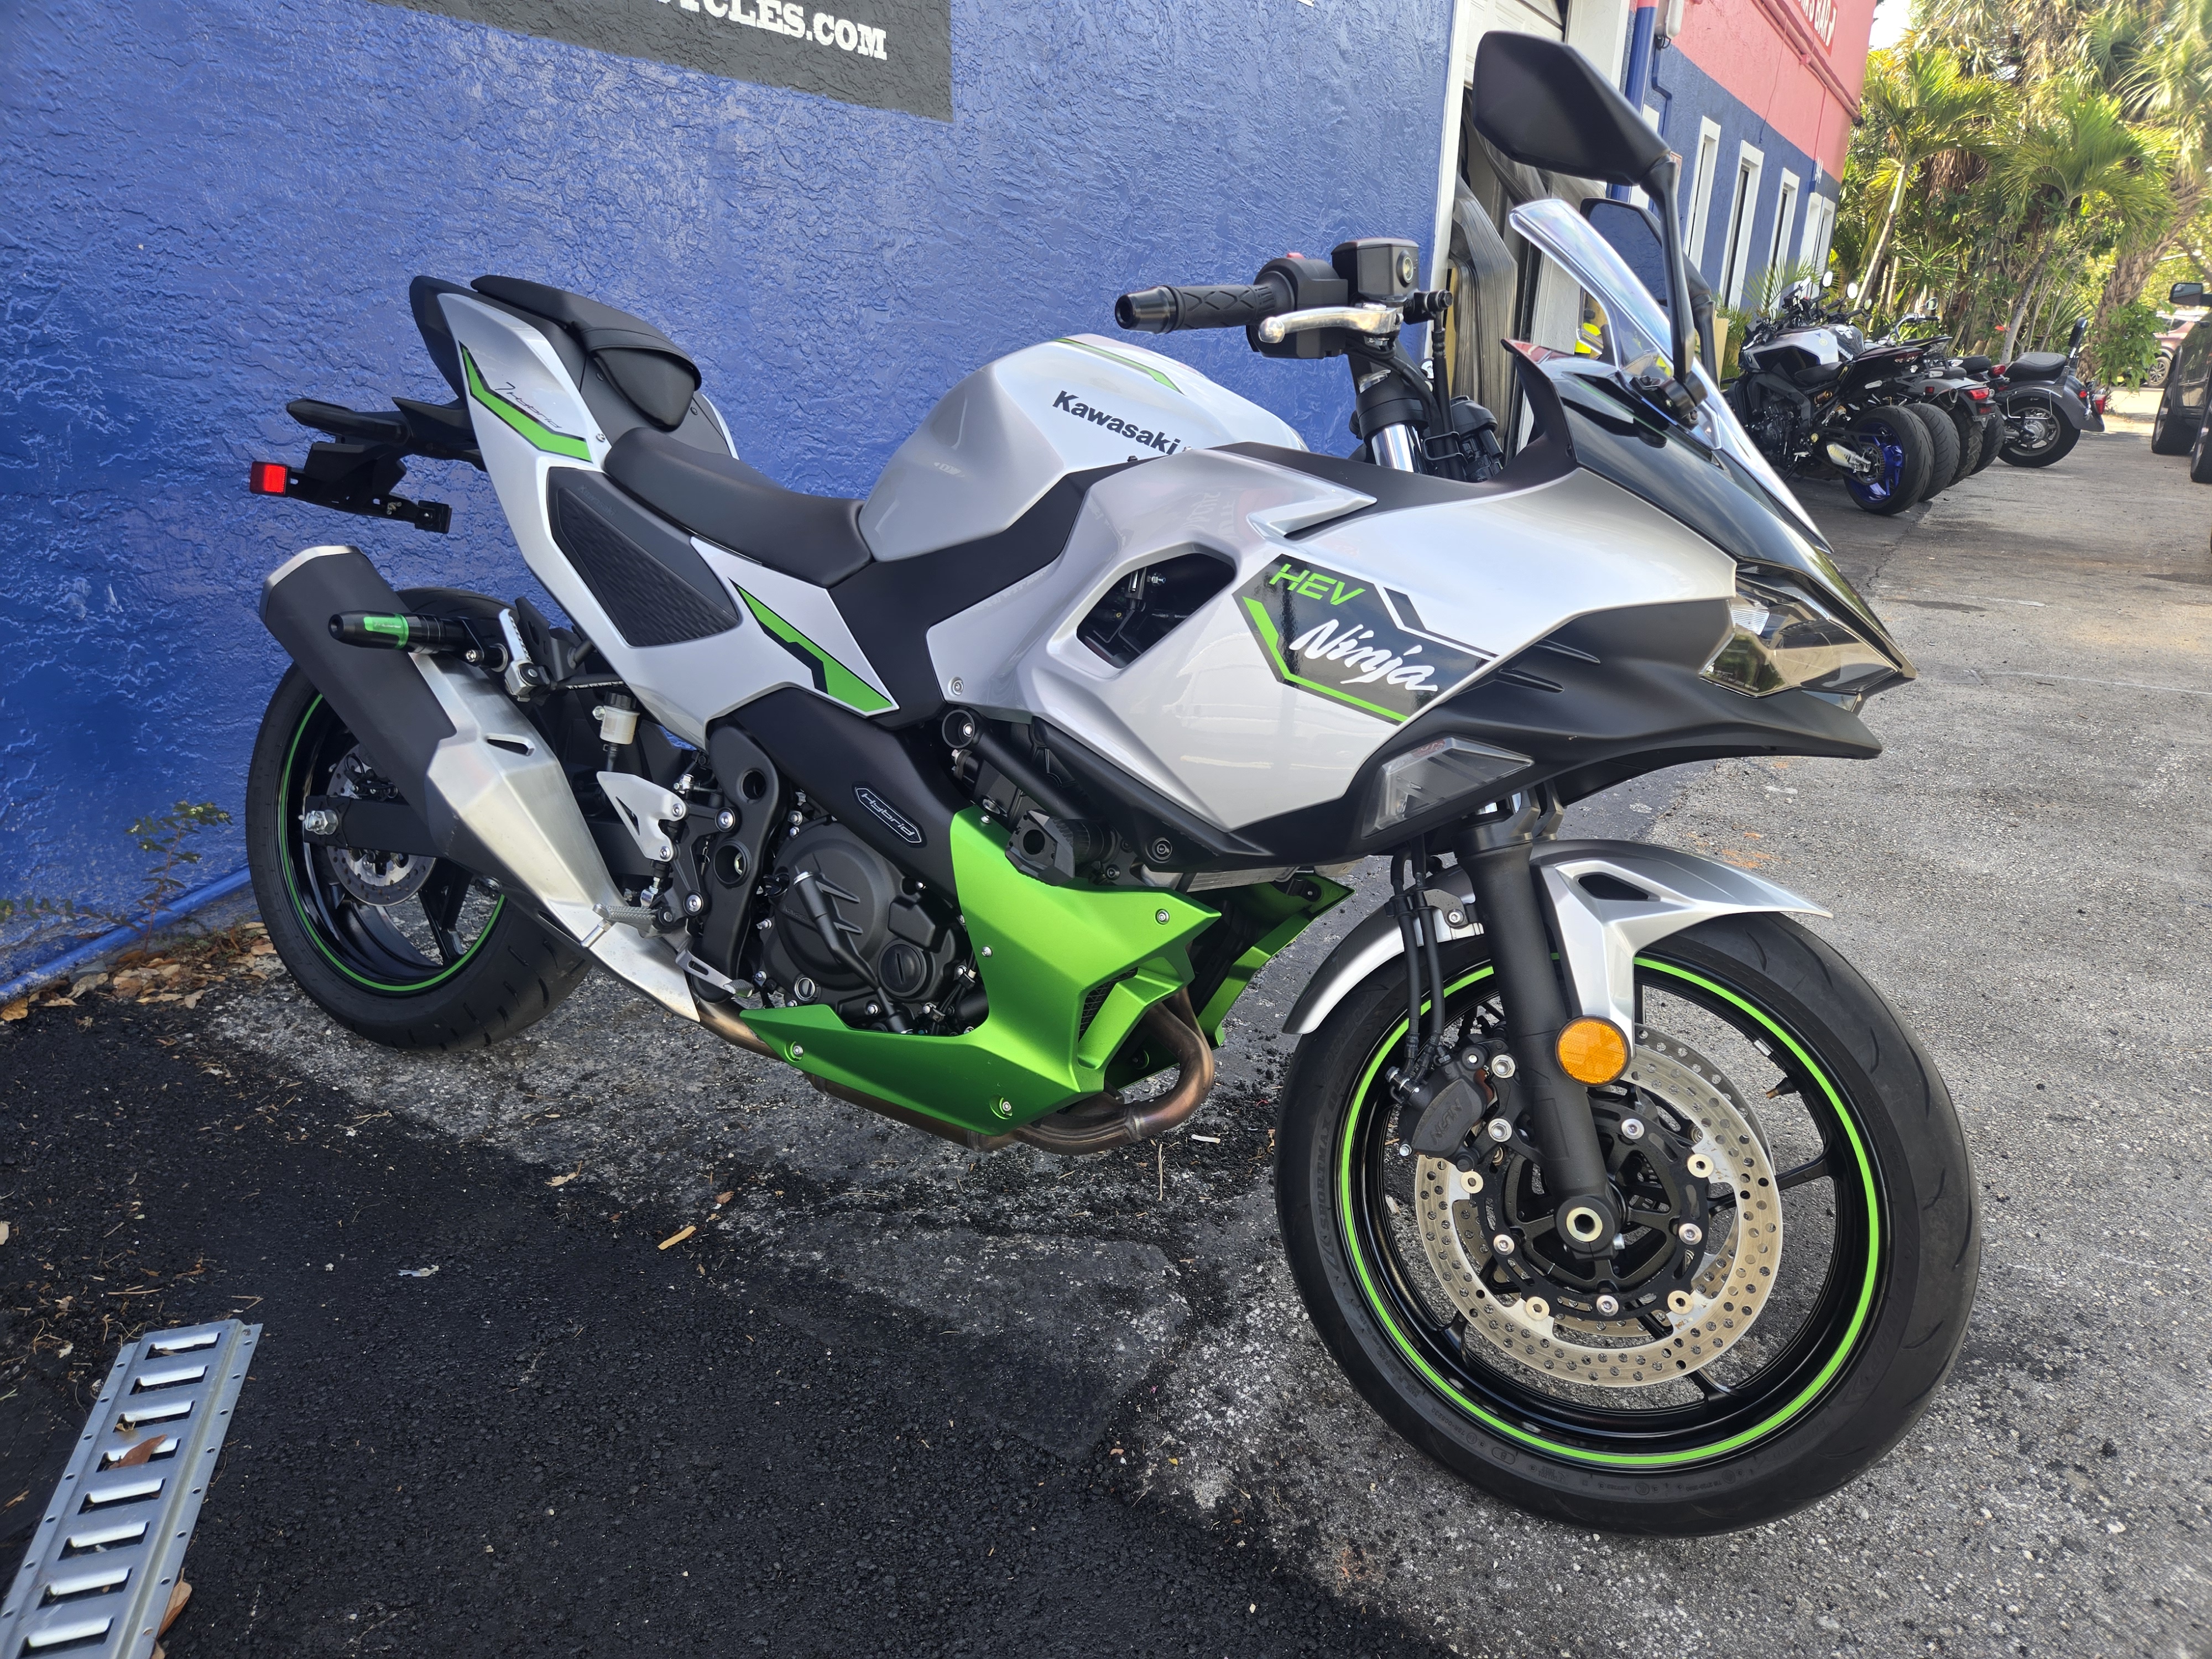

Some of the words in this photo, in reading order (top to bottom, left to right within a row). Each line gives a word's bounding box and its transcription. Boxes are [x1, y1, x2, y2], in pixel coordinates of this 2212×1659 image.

[656, 0, 887, 60] CLES.COM
[506, 392, 562, 428] Hybrid
[1052, 390, 1181, 455] Kawasaki
[1269, 564, 1366, 606] HEV
[1289, 619, 1438, 691] Ninja
[861, 793, 915, 836] Hybrid
[1316, 1115, 1332, 1232] SPORTMAX
